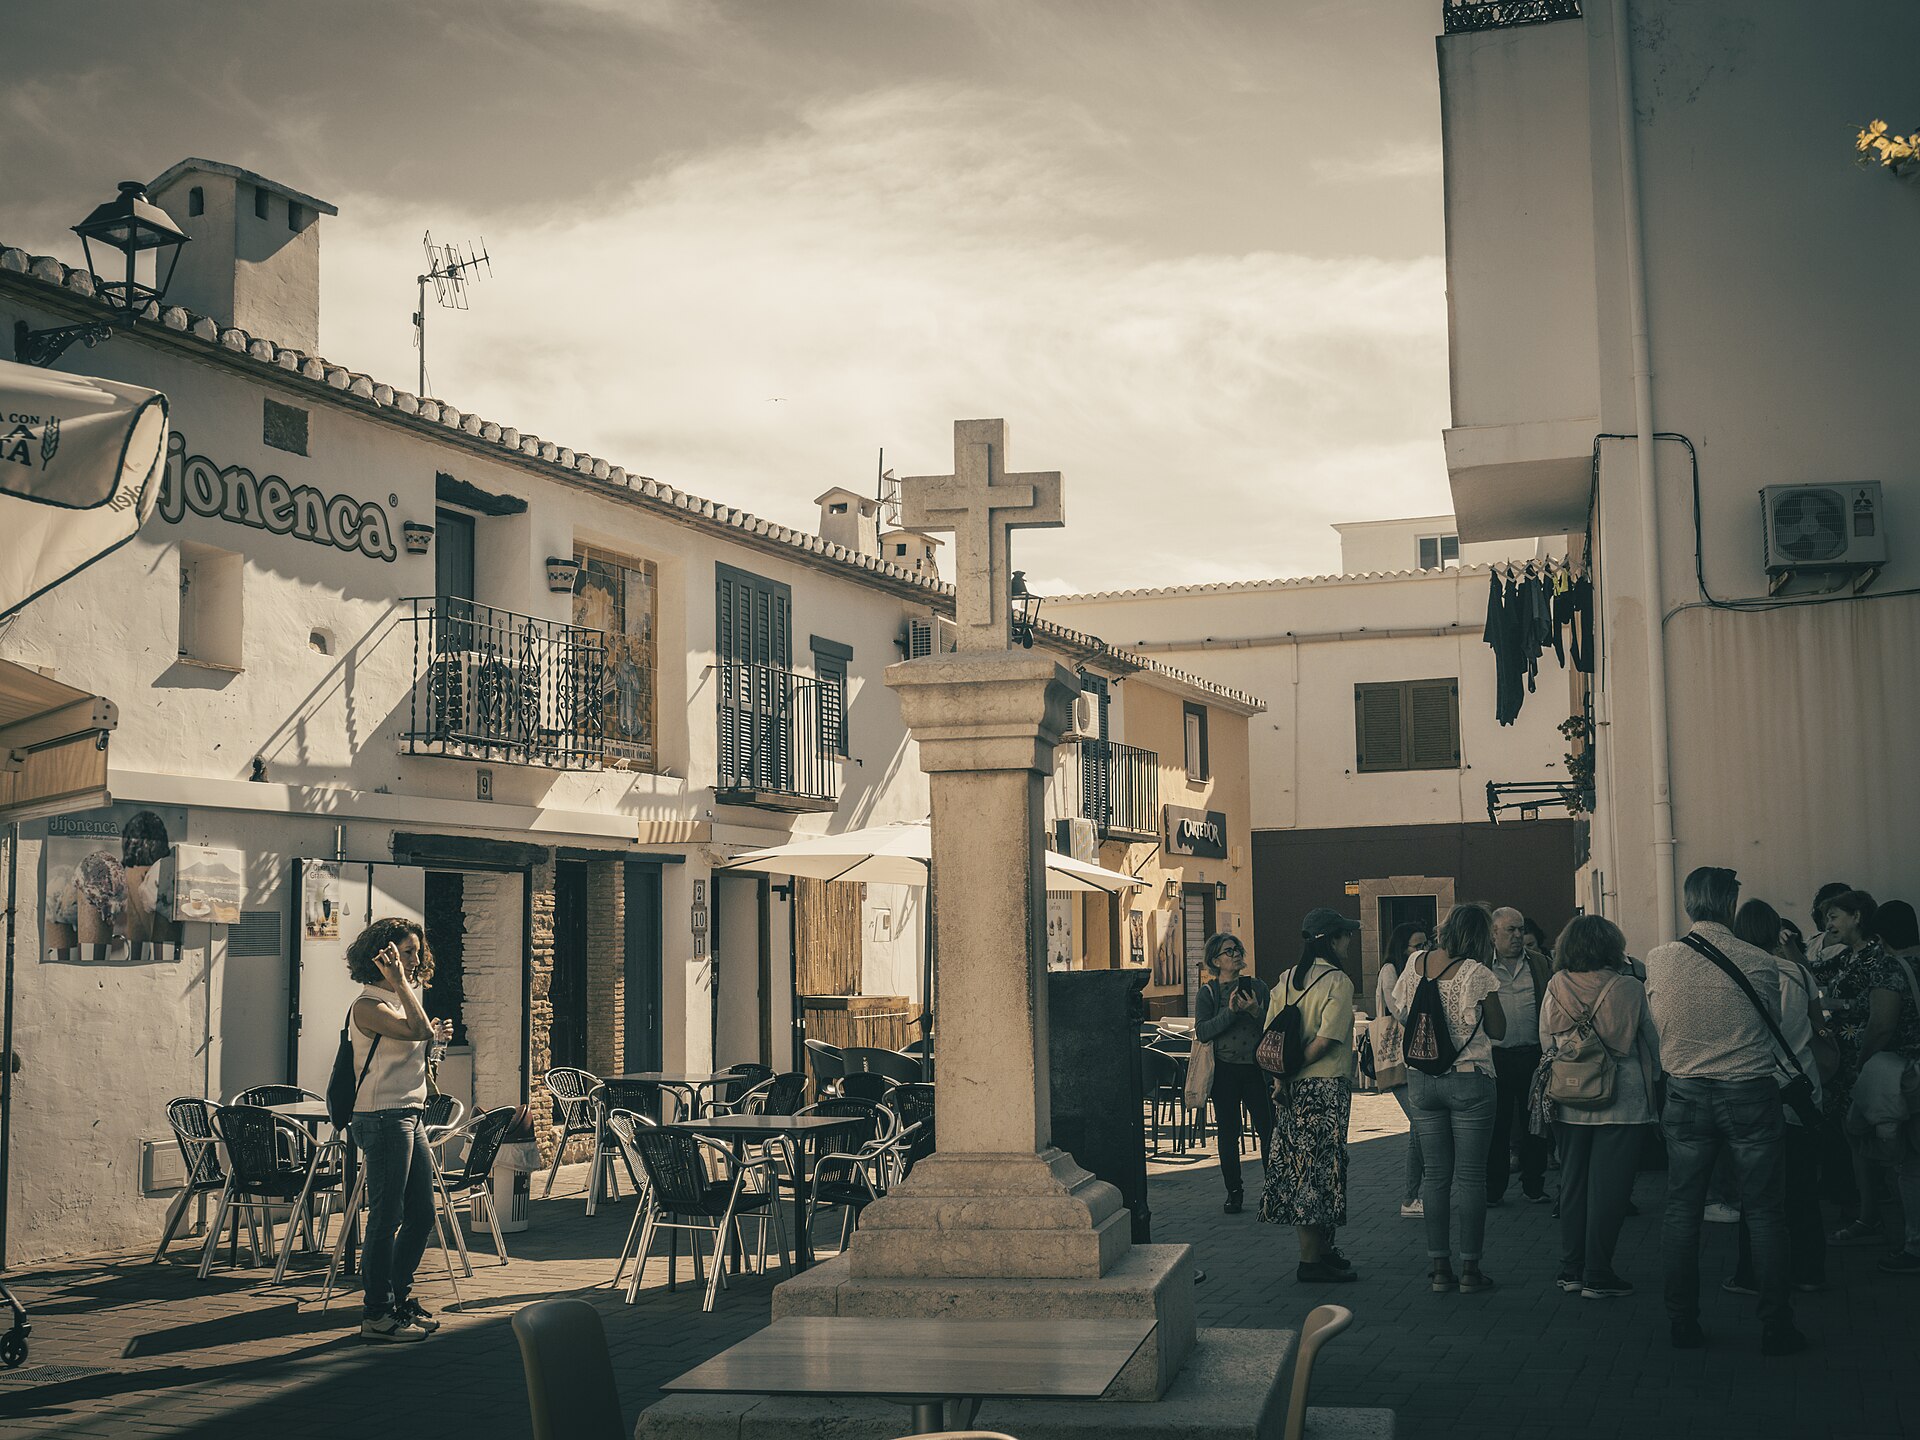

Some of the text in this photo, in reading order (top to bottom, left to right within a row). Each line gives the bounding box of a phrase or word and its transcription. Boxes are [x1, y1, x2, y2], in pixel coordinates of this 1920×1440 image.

[9, 413, 40, 424] CON
[157, 431, 397, 562] jonenca
[482, 777, 488, 793] 9
[50, 815, 119, 834] Jijonenca
[697, 885, 702, 900] 2
[695, 912, 705, 927] 10
[697, 939, 702, 954] 1
